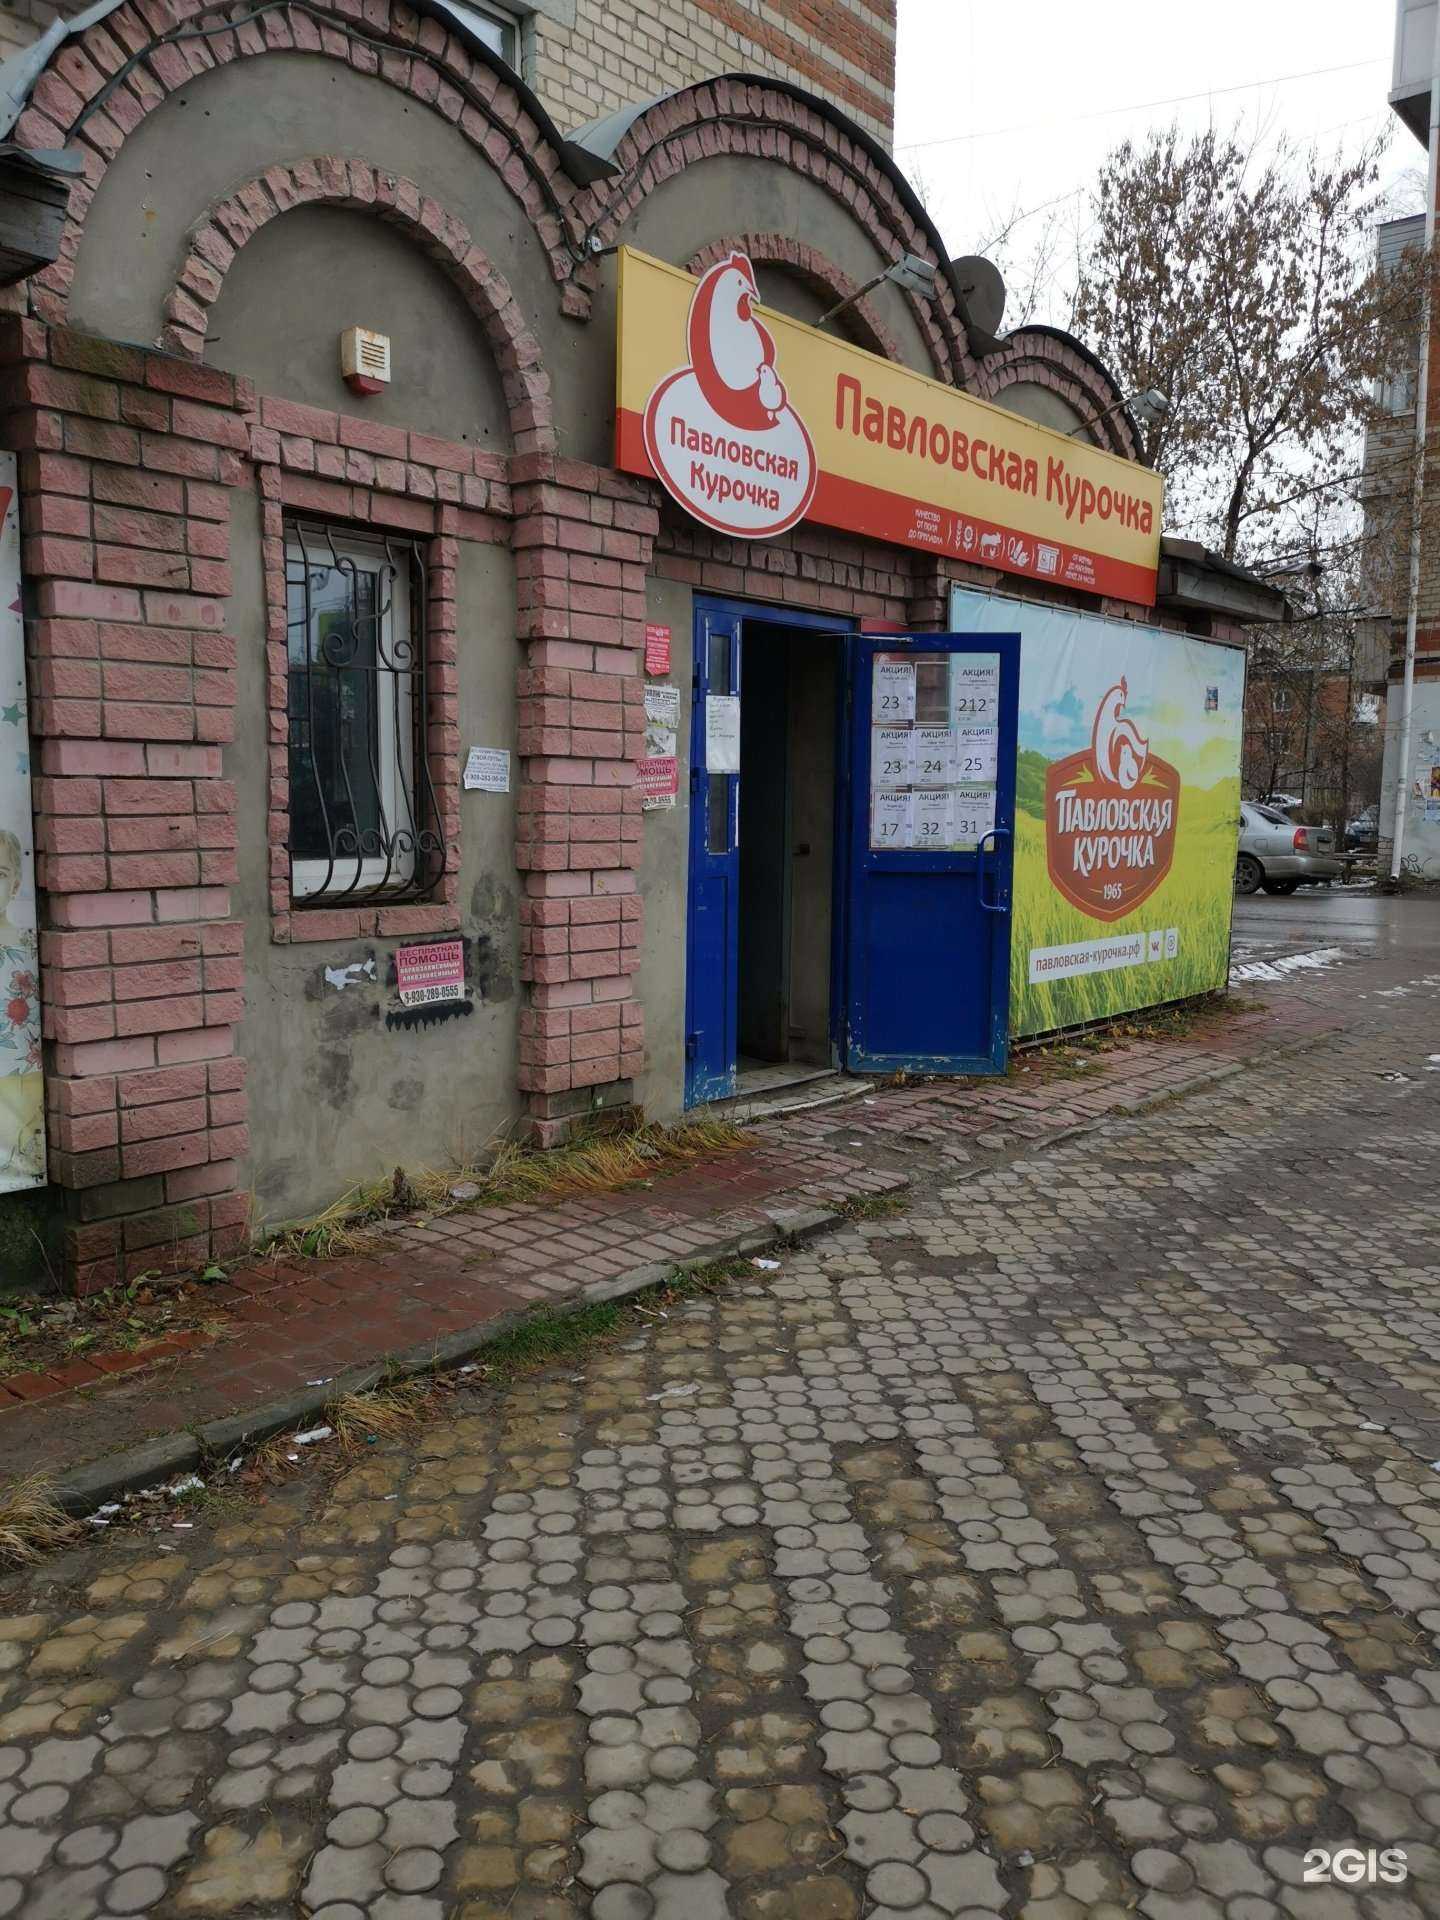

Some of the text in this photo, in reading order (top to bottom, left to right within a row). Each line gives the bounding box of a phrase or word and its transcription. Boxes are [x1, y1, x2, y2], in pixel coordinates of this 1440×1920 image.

[670, 416, 799, 481] Павловская
[835, 372, 1154, 535] Павловская Курочка
[690, 461, 780, 511] Курочка
[880, 665, 912, 675] АКЦИЯ!
[962, 668, 994, 678] АКЦИЯ!
[881, 695, 900, 710] 23
[959, 698, 987, 712] 212
[880, 731, 912, 741] АКЦИЯ!
[920, 729, 952, 739] АКЦИЯ!
[961, 728, 993, 738] АКЦИЯ!
[883, 760, 902, 775] 23
[923, 760, 942, 774] 24
[964, 758, 983, 772] 25
[637, 767, 672, 778] МОЩЬ
[880, 793, 911, 803] АКЦИЯ!
[918, 792, 950, 802] АКЦИЯ!
[959, 791, 991, 801] АКЦИЯ!
[1055, 789, 1173, 837] ПАВЛОВСКАЯ
[881, 823, 899, 837] 17
[921, 822, 940, 836] 32
[959, 820, 978, 835] 31
[1072, 834, 1155, 877] КУРОЧКА
[1103, 883, 1122, 900] 1965
[400, 944, 459, 957] БЕСПЛАТНАЯ
[1035, 940, 1141, 972] павловская-курочка.рф
[399, 951, 460, 967] ПОМОЩЬ
